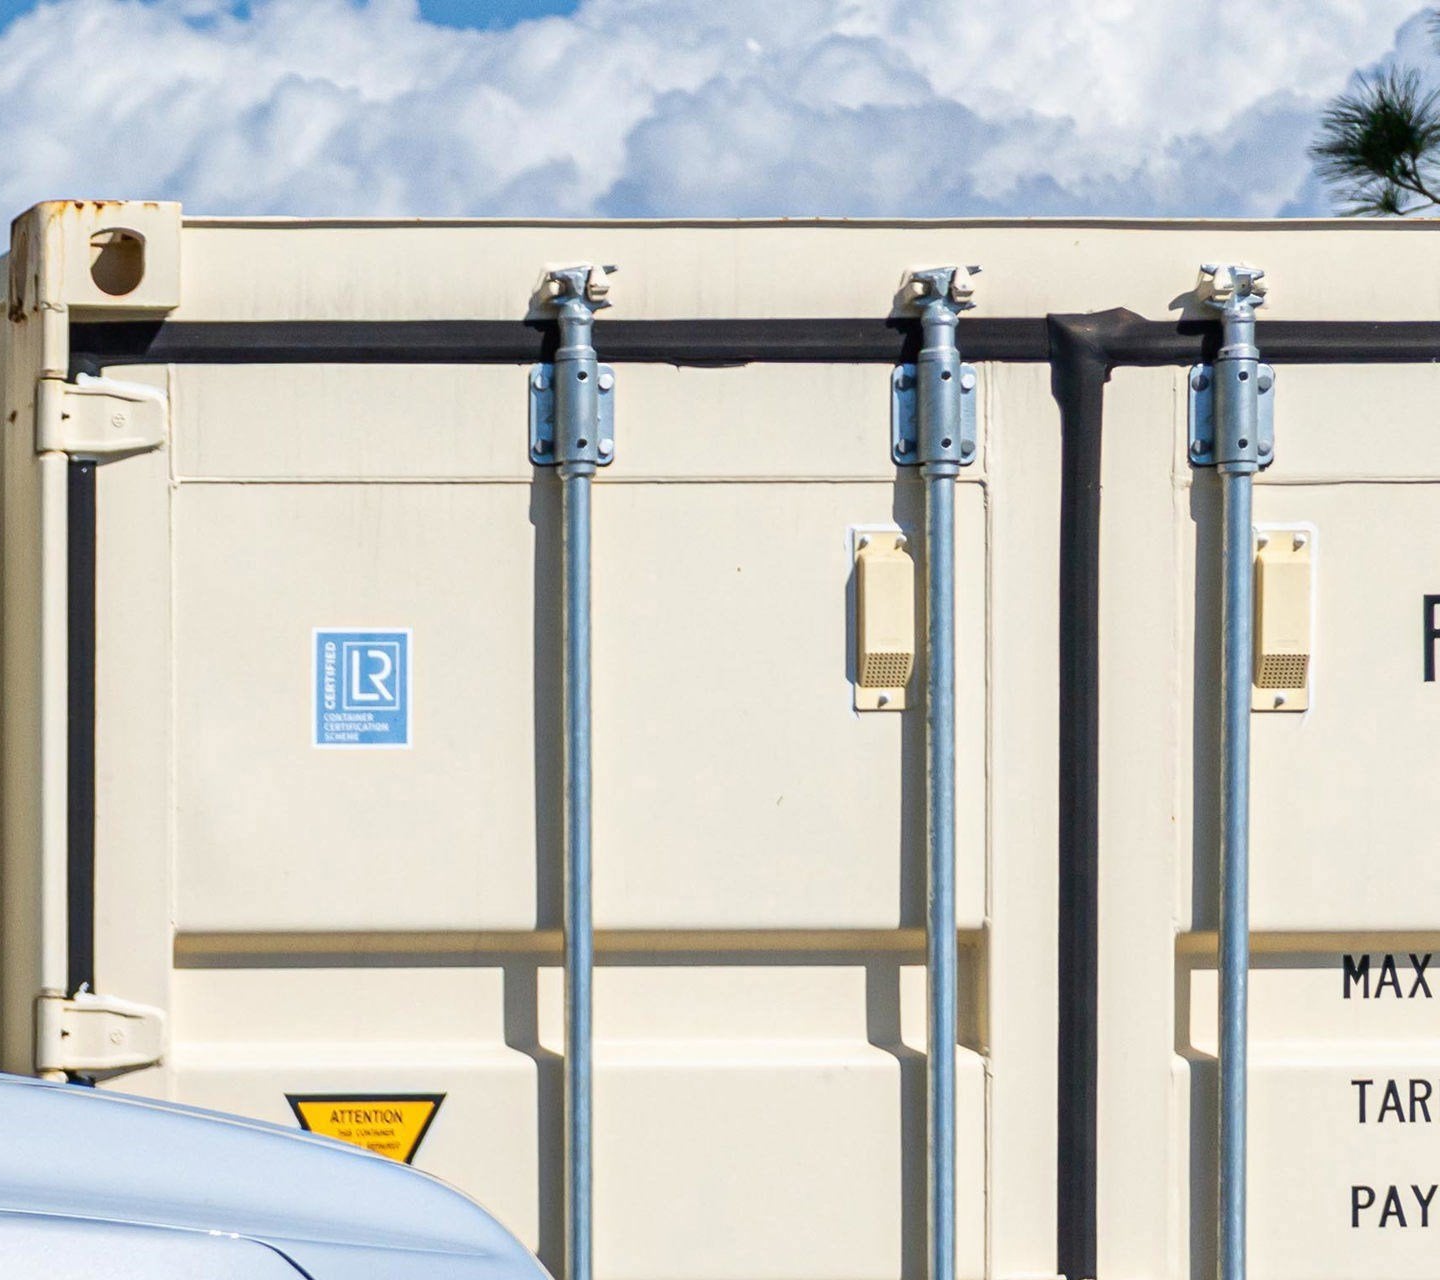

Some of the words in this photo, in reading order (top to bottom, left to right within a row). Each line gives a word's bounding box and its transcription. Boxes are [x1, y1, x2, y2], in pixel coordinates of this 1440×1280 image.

[352, 650, 394, 701] LR
[1343, 953, 1433, 998] MAX
[330, 1109, 403, 1124] ATTENTION
[1351, 1079, 1440, 1123] TAR
[1351, 1184, 1439, 1227] PAY
